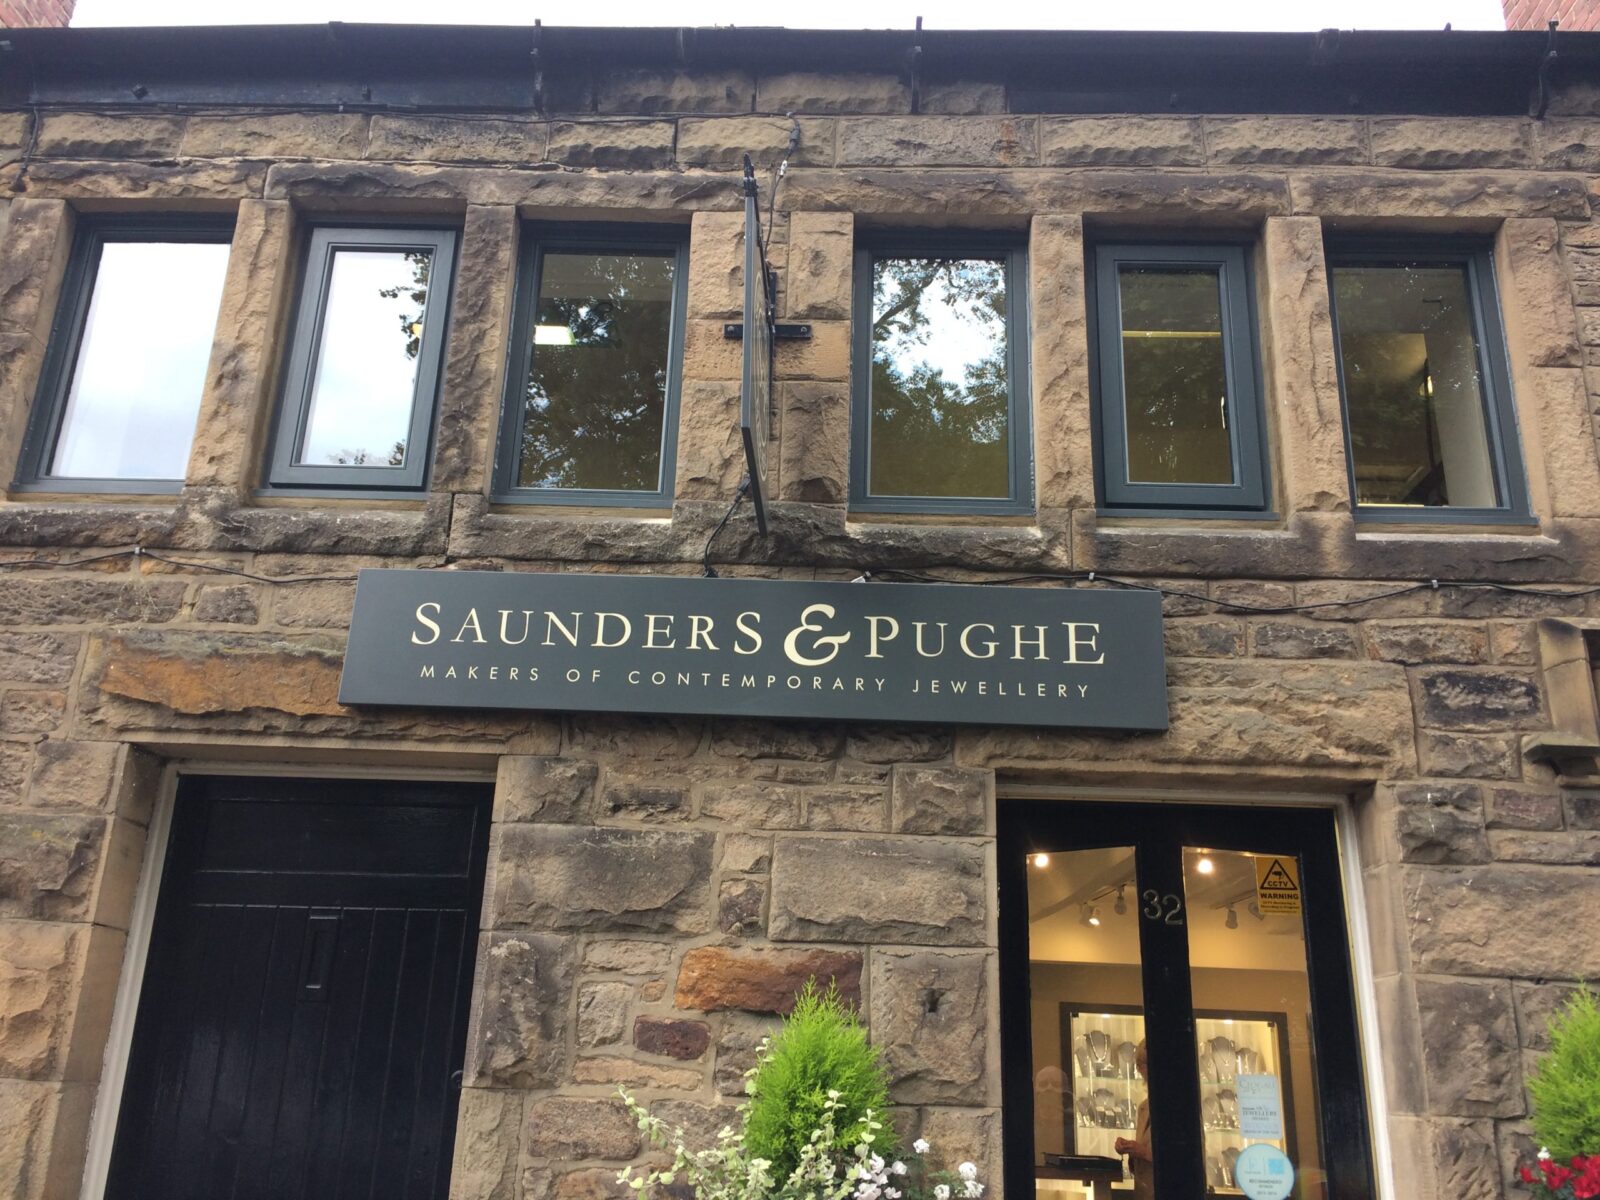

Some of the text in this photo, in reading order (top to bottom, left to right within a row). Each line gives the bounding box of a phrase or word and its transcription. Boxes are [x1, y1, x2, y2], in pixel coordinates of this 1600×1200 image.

[410, 601, 1105, 667] SAUNDERS & PUGHE
[420, 664, 1088, 698] MAKERS OF CONTEMPORARY JEWELLERY
[1143, 889, 1183, 925] 32
